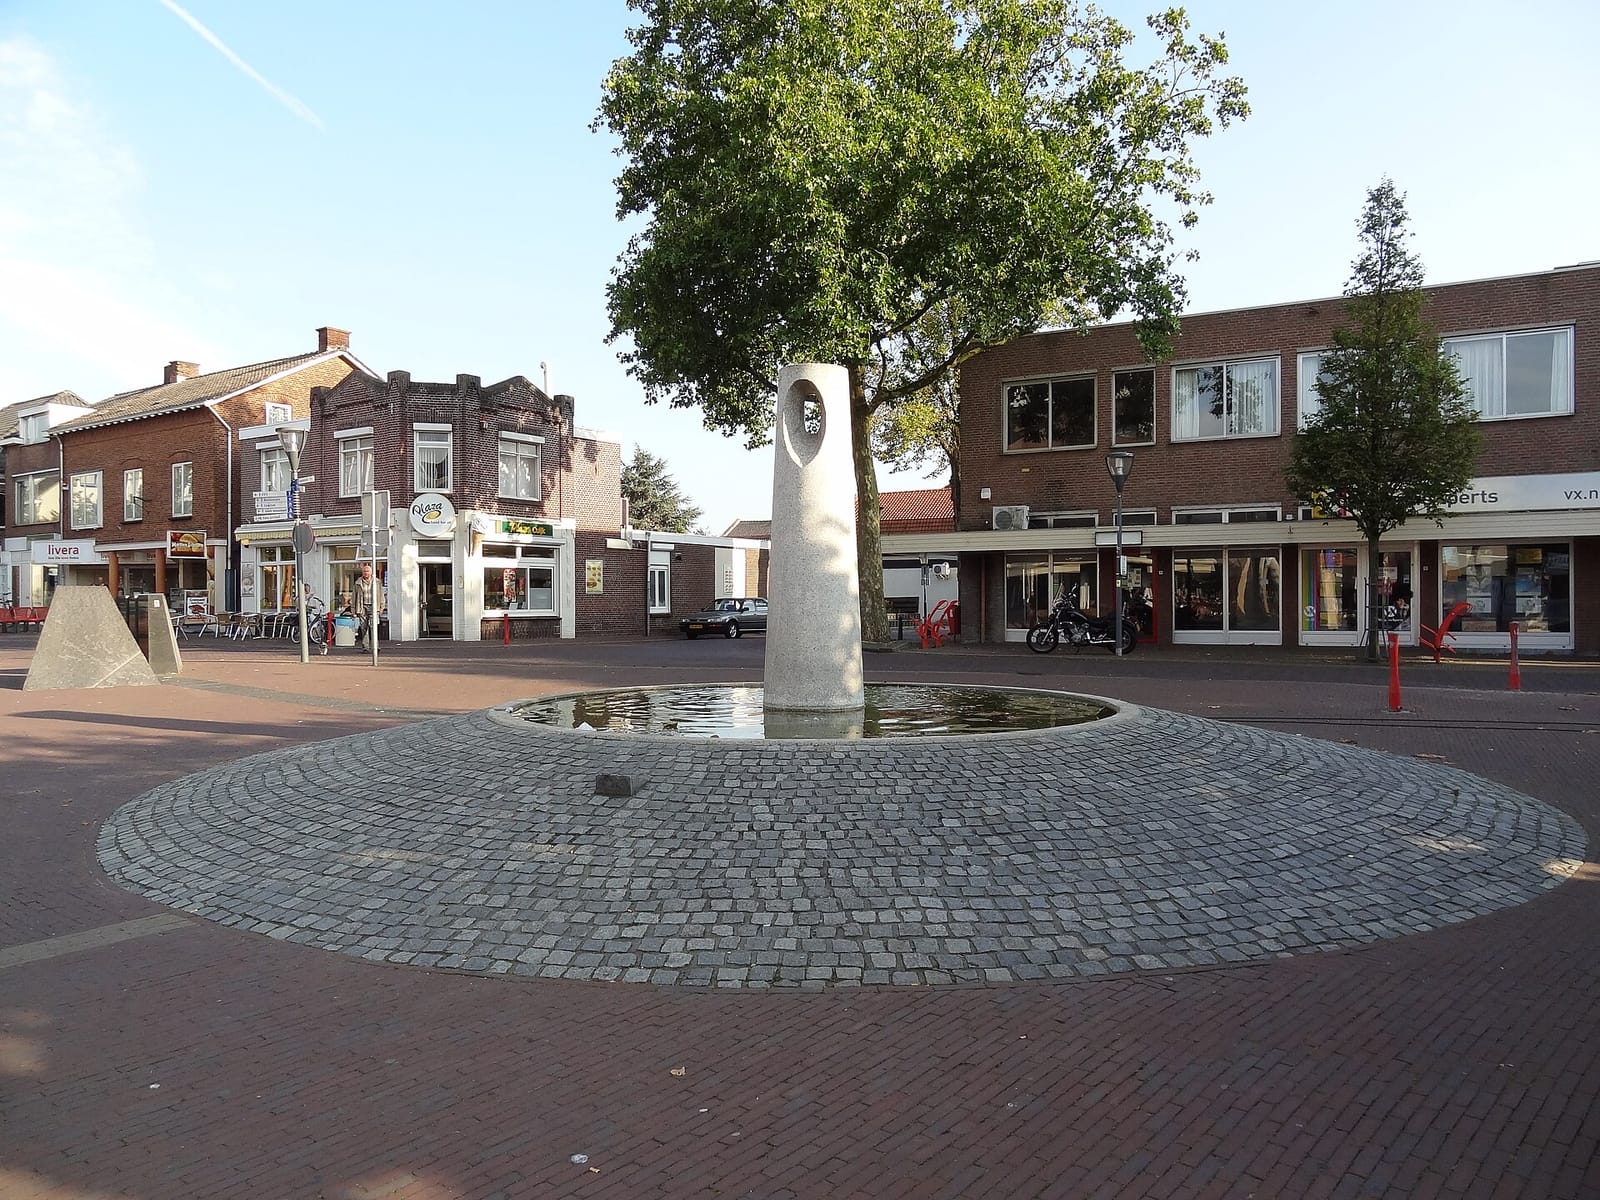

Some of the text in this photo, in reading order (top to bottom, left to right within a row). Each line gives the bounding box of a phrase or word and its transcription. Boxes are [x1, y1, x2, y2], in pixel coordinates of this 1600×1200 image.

[1441, 490, 1498, 507] perts
[412, 502, 443, 516] Plaza
[48, 544, 79, 555] livera
